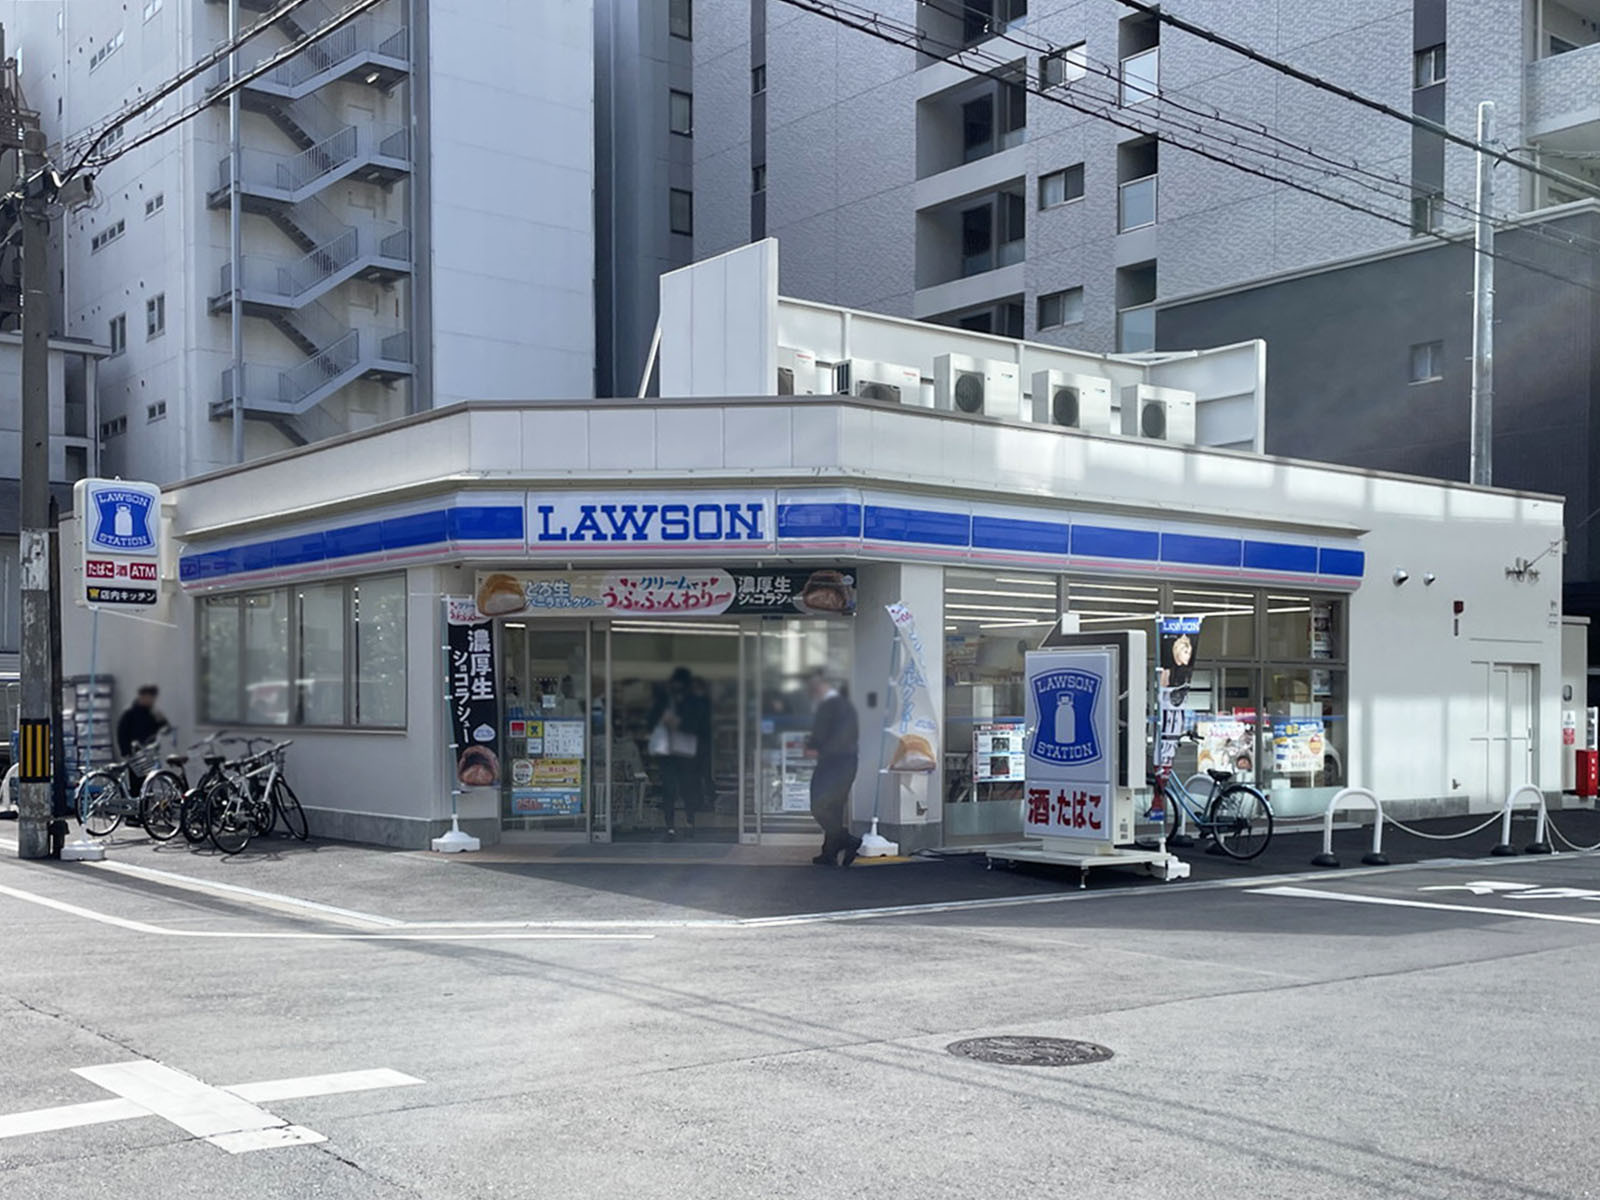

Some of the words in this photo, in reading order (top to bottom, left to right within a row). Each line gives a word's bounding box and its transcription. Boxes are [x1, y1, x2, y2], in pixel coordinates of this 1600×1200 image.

[98, 493, 148, 507] LAWSON
[537, 504, 764, 541] LAWSON
[98, 532, 148, 546] STATION
[88, 562, 114, 576] たばこ
[131, 565, 156, 578] ATM
[738, 576, 792, 594] 濃厚生
[100, 590, 156, 602] 店内キッチン
[467, 628, 494, 700] 濃厚生
[1036, 674, 1095, 694] LAWSON
[453, 650, 471, 743] ショコラシュー
[1036, 741, 1093, 760] STATION
[1027, 788, 1102, 830] 酒・たばこ
